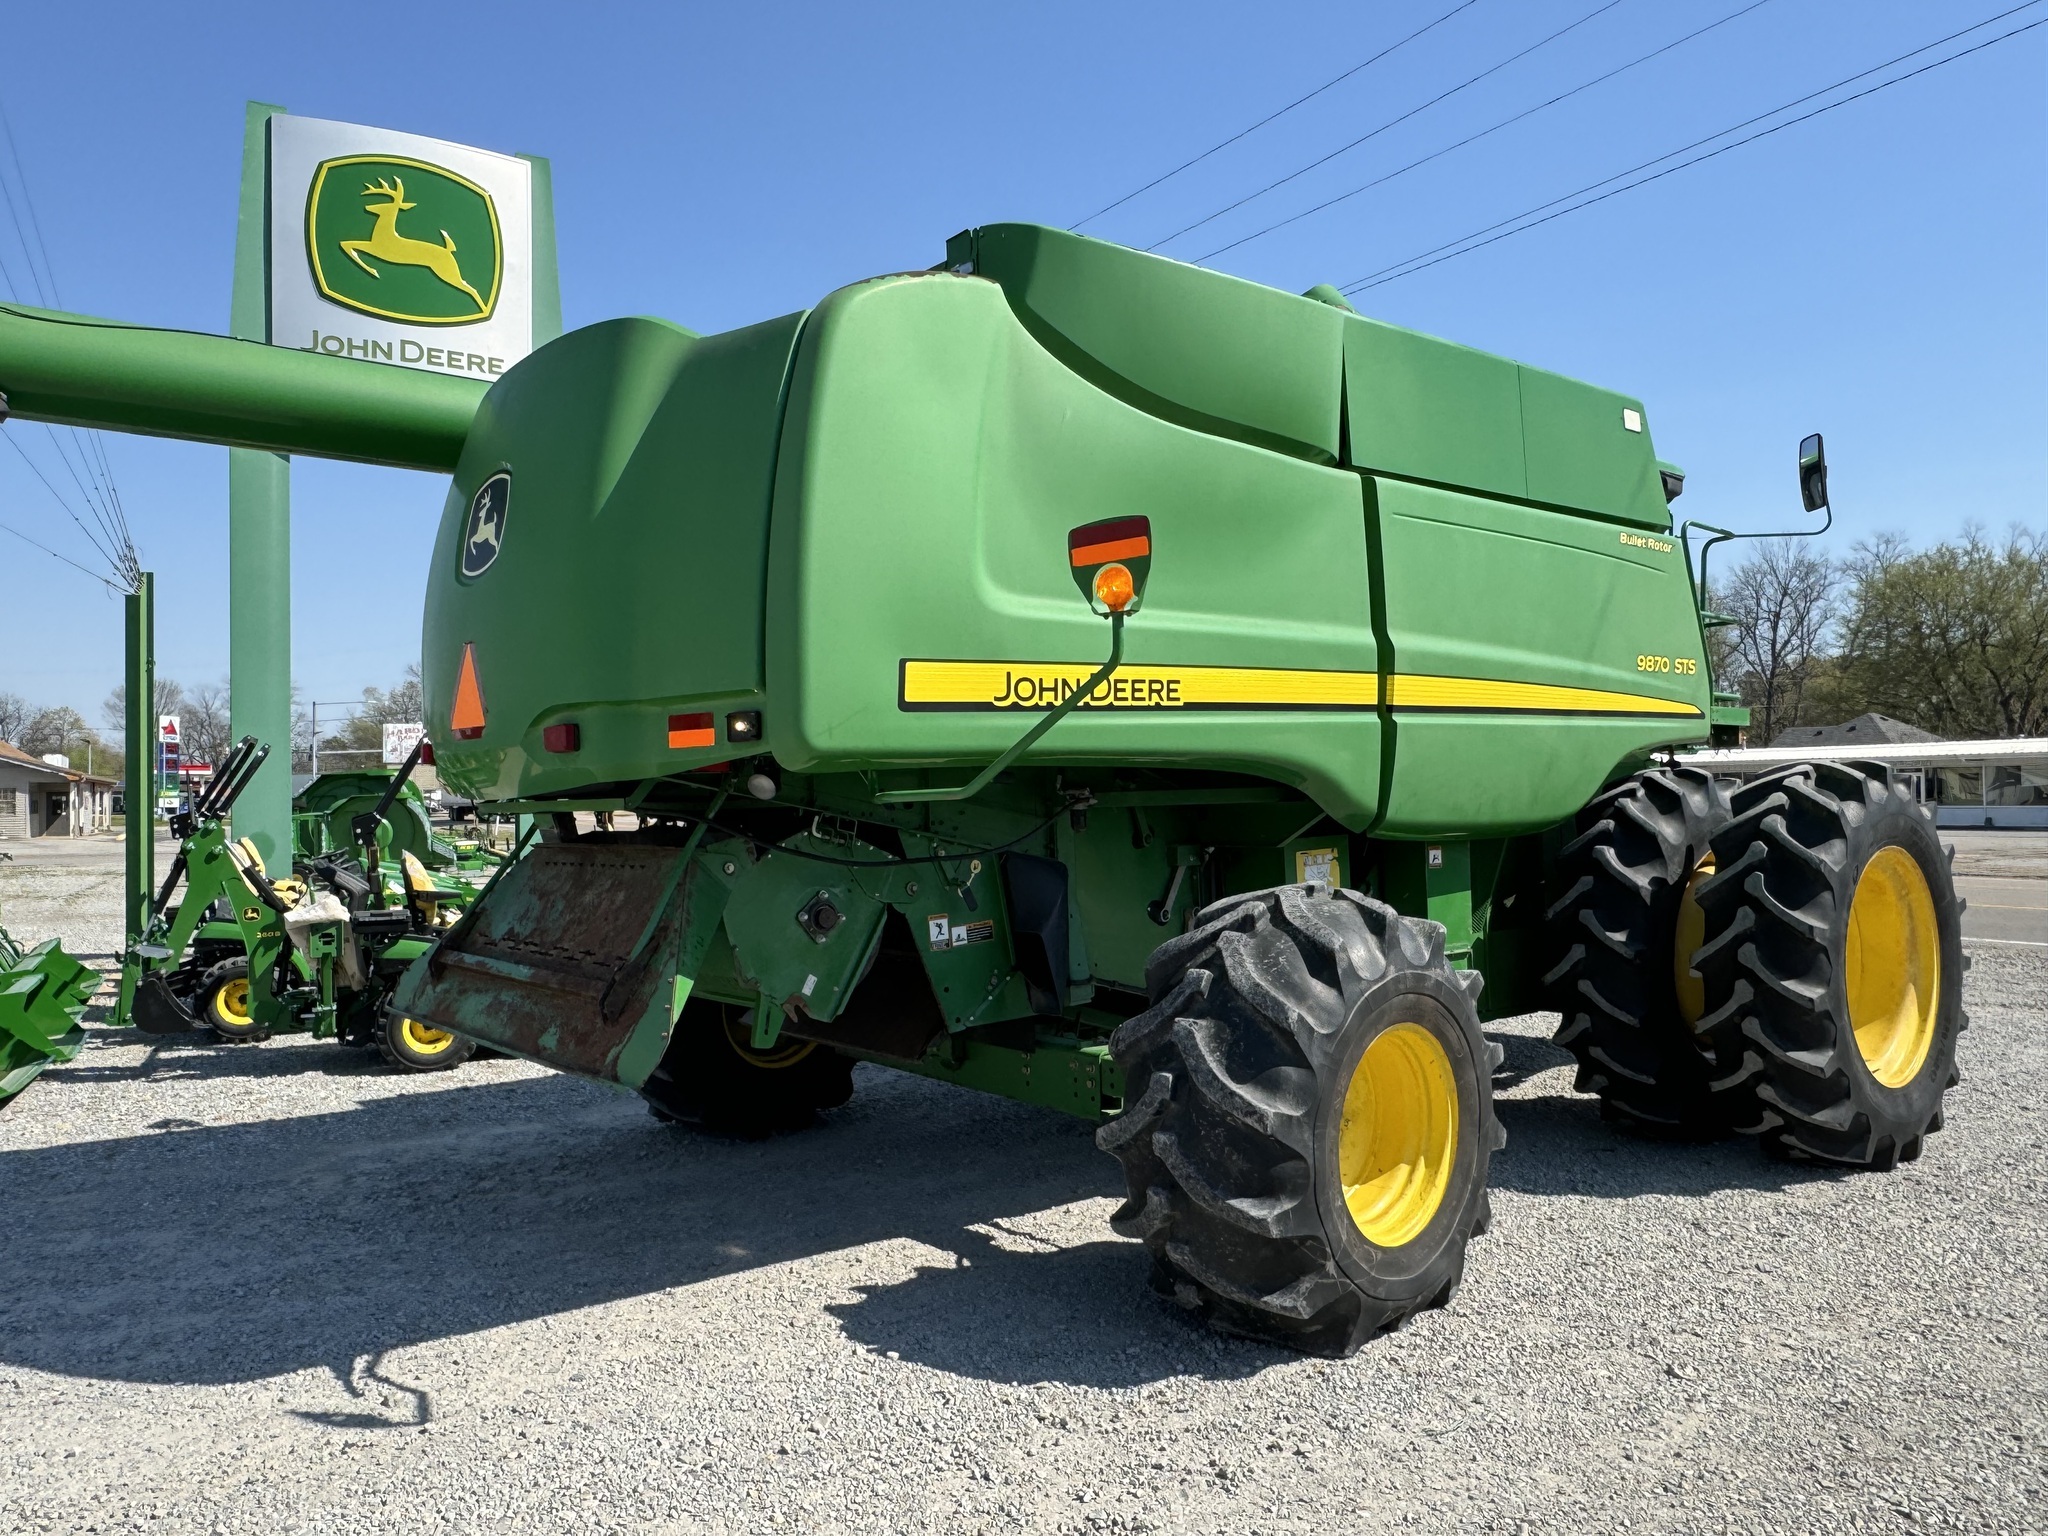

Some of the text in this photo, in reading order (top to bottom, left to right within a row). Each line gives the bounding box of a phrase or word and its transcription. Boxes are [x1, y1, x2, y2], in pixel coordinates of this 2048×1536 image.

[300, 329, 505, 376] JOHN DEERE
[1619, 532, 1674, 554] Bullet Rotor
[1637, 654, 1697, 675] 9870 STS
[993, 671, 1182, 702] JOHN DEERE
